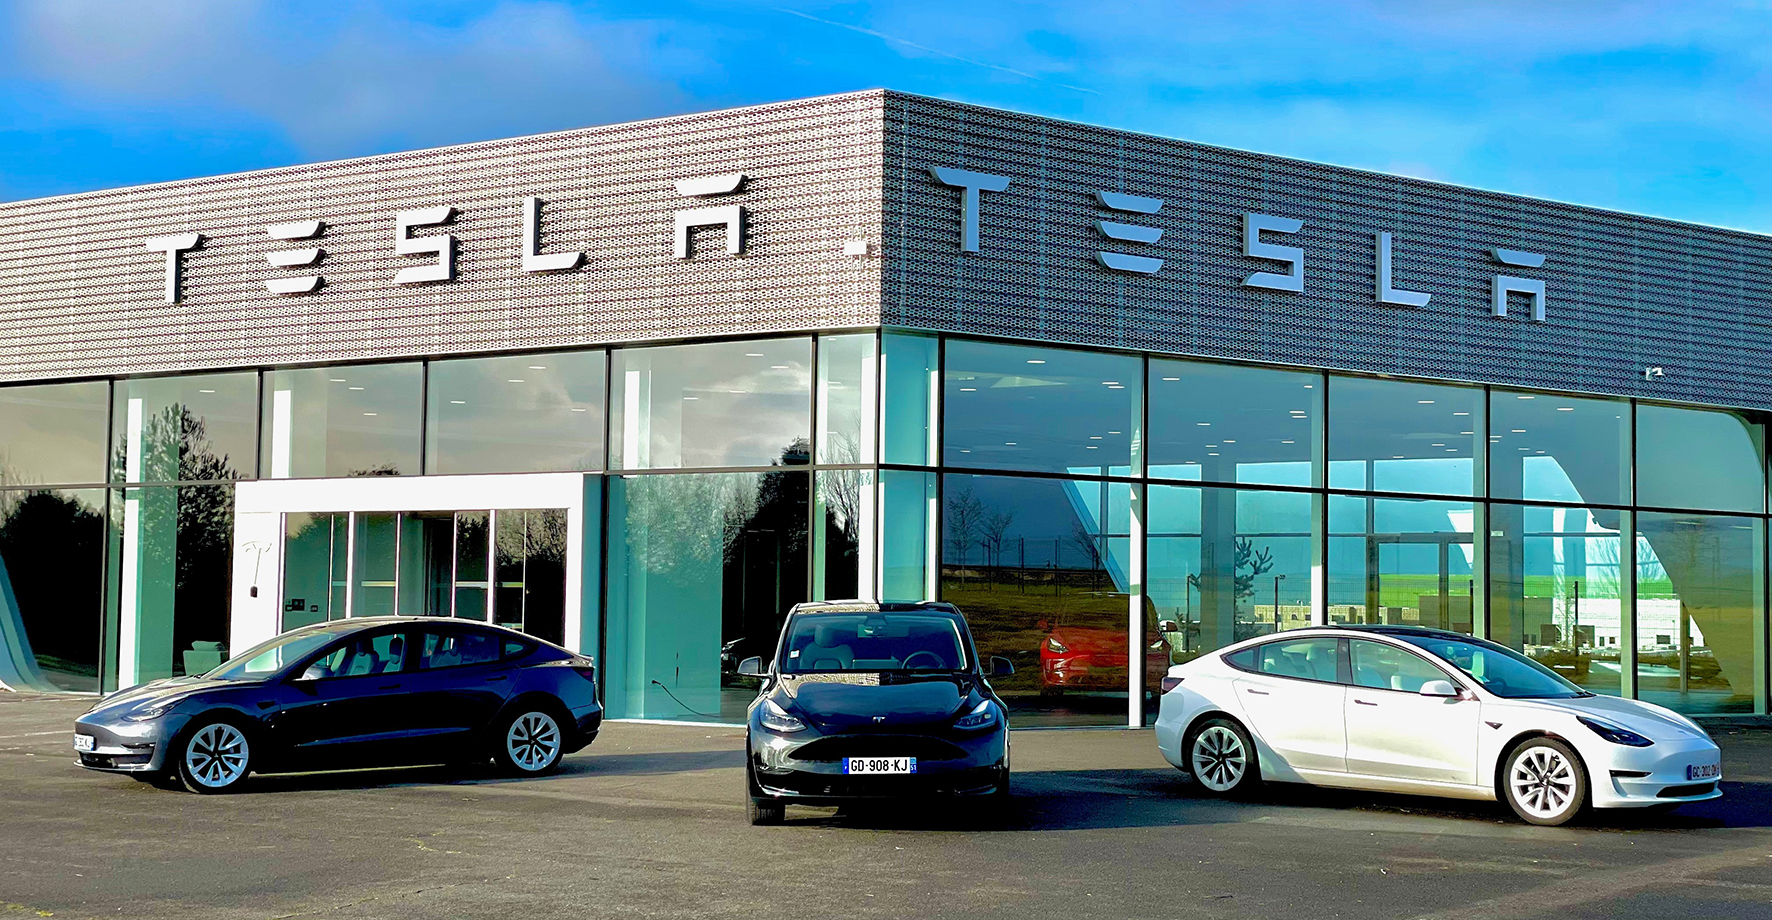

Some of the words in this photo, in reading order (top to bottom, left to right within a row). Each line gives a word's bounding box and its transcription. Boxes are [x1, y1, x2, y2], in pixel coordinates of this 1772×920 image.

[146, 173, 748, 304] TESLA
[931, 166, 1546, 321] TESLA
[851, 759, 908, 772] GD-908-KJ
